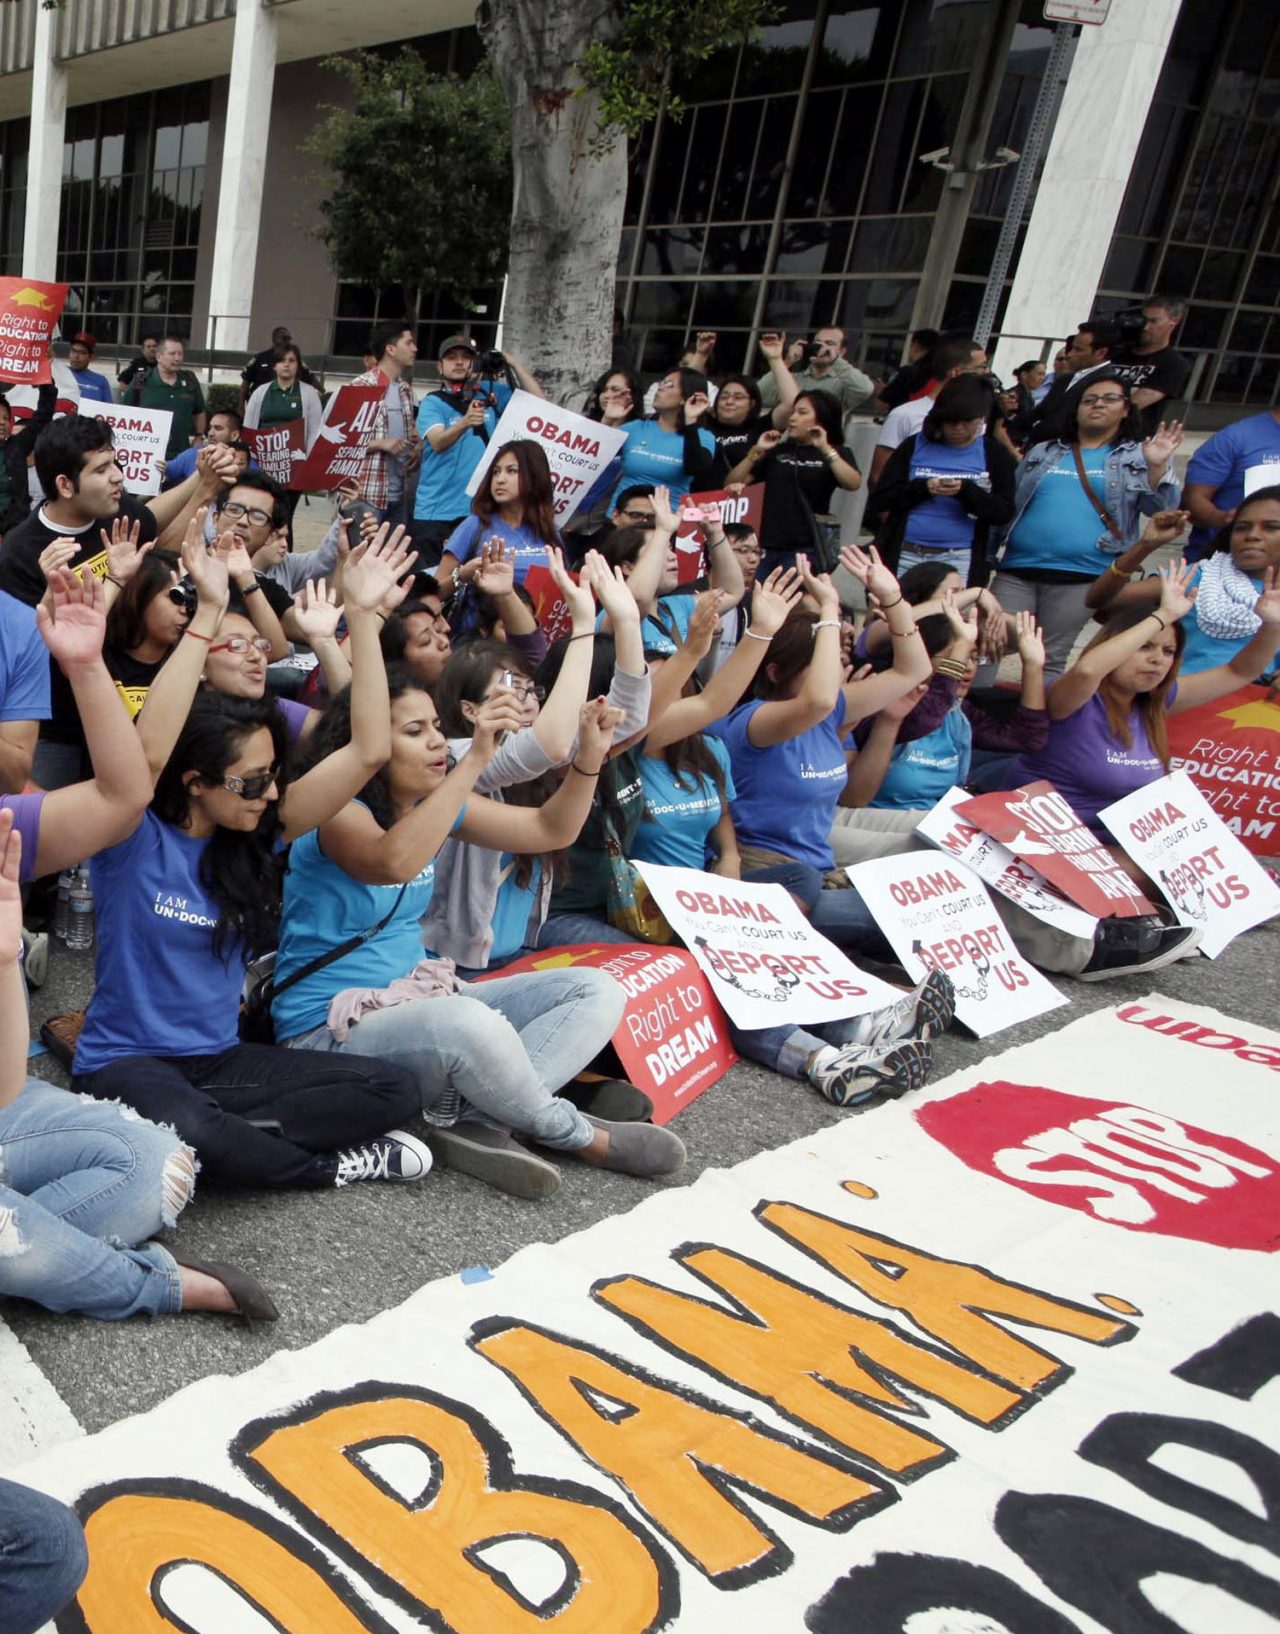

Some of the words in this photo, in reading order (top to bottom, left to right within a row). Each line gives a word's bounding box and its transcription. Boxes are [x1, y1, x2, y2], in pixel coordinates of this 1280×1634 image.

[0, 312, 35, 329] Right
[38, 319, 49, 331] to
[31, 345, 42, 358] to
[121, 433, 148, 443] COURT
[149, 436, 161, 445] US
[255, 429, 291, 451] STOP
[525, 416, 602, 458] OBAMA
[114, 448, 154, 466] ORT
[257, 448, 291, 462] TEARING
[325, 458, 363, 478] FAMIL
[557, 451, 591, 469] COURT
[588, 460, 601, 472] US
[126, 468, 151, 482] US
[266, 469, 291, 484] ART
[550, 471, 585, 496] ORT
[717, 497, 750, 524] TOP
[1112, 751, 1128, 759] AM
[1189, 738, 1269, 768] Right
[1195, 783, 1251, 812] ght
[1128, 801, 1188, 844] OBAMA
[1162, 826, 1190, 849] COURT
[1191, 818, 1209, 833] US
[155, 892, 162, 903] I
[164, 896, 188, 910] AM
[888, 869, 967, 908] OBAMA
[1206, 874, 1251, 911] US
[675, 889, 783, 925] OBAMA
[942, 897, 974, 917] COURT
[974, 894, 987, 908] US
[741, 925, 786, 941] COURT
[789, 930, 808, 942] US
[598, 952, 635, 980] ght
[632, 949, 652, 966] to
[702, 945, 832, 977] DEPORT
[620, 952, 687, 1002] UCATION
[992, 958, 1031, 992] US
[804, 979, 869, 1001] US
[625, 997, 681, 1048] Right
[678, 984, 703, 1014] to
[644, 1014, 719, 1087] DREAM
[992, 1106, 1274, 1226] STOP
